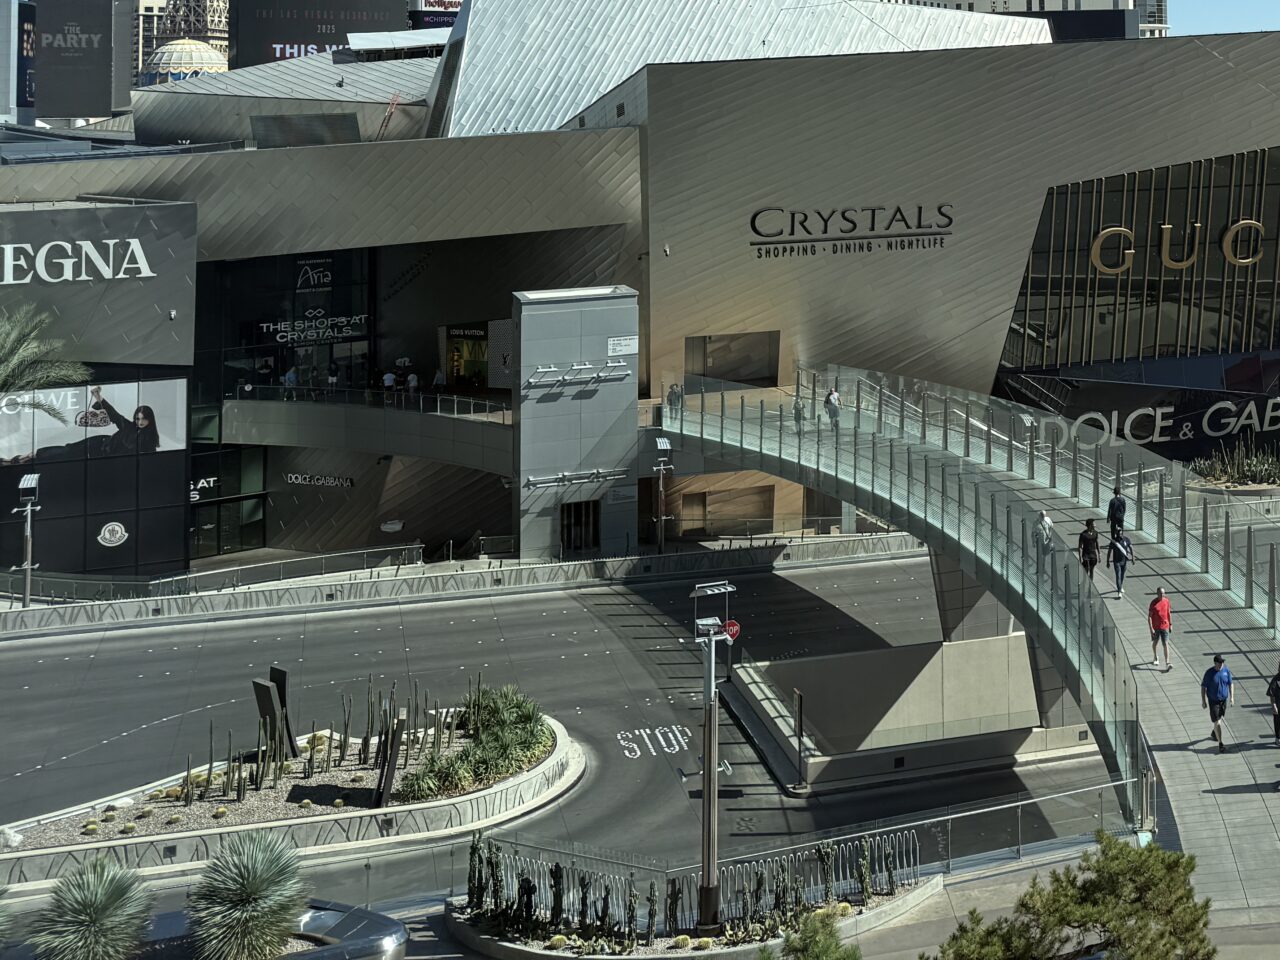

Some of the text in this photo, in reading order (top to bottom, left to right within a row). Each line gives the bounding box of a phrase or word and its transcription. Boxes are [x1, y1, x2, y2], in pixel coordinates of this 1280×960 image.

[316, 24, 336, 33] 2025
[41, 33, 103, 48] PARTY
[272, 44, 318, 57] THIS
[757, 237, 945, 258] SHOPPING DINING NIGHTLIFE
[0, 239, 157, 285] EGNA
[297, 265, 332, 288] Aria
[259, 314, 368, 332] THE SHOPS AT
[276, 327, 353, 343] CRYSTALS
[0, 391, 80, 415] OEWE
[1039, 405, 1175, 451] DOLCE
[1178, 422, 1195, 440] &
[287, 473, 311, 485] DOLCE
[315, 476, 351, 487] GABBANA
[617, 725, 692, 758] STOP
